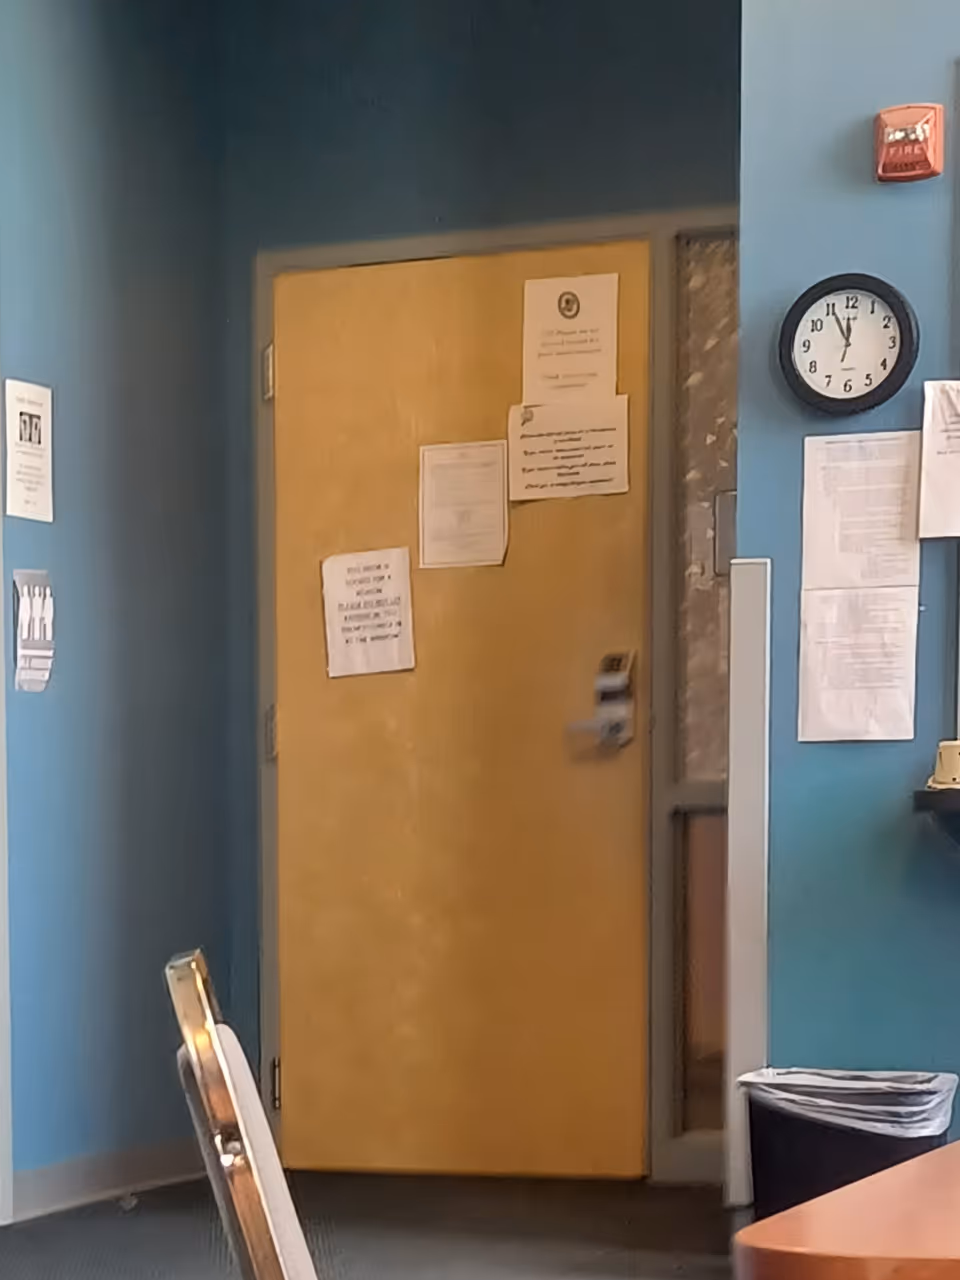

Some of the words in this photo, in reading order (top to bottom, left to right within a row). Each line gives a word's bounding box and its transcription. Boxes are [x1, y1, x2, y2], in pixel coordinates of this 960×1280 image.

[889, 144, 922, 156] FIRE
[826, 302, 836, 317] 11
[844, 295, 859, 310] 12
[870, 299, 877, 315] 1
[810, 318, 824, 333] 10
[882, 315, 892, 329] 2
[802, 339, 811, 353] 9
[888, 336, 897, 350] 3
[808, 360, 817, 374] 8
[880, 358, 888, 371] 4
[824, 374, 833, 388] 7
[843, 379, 853, 393] 6
[864, 373, 873, 387] 5
